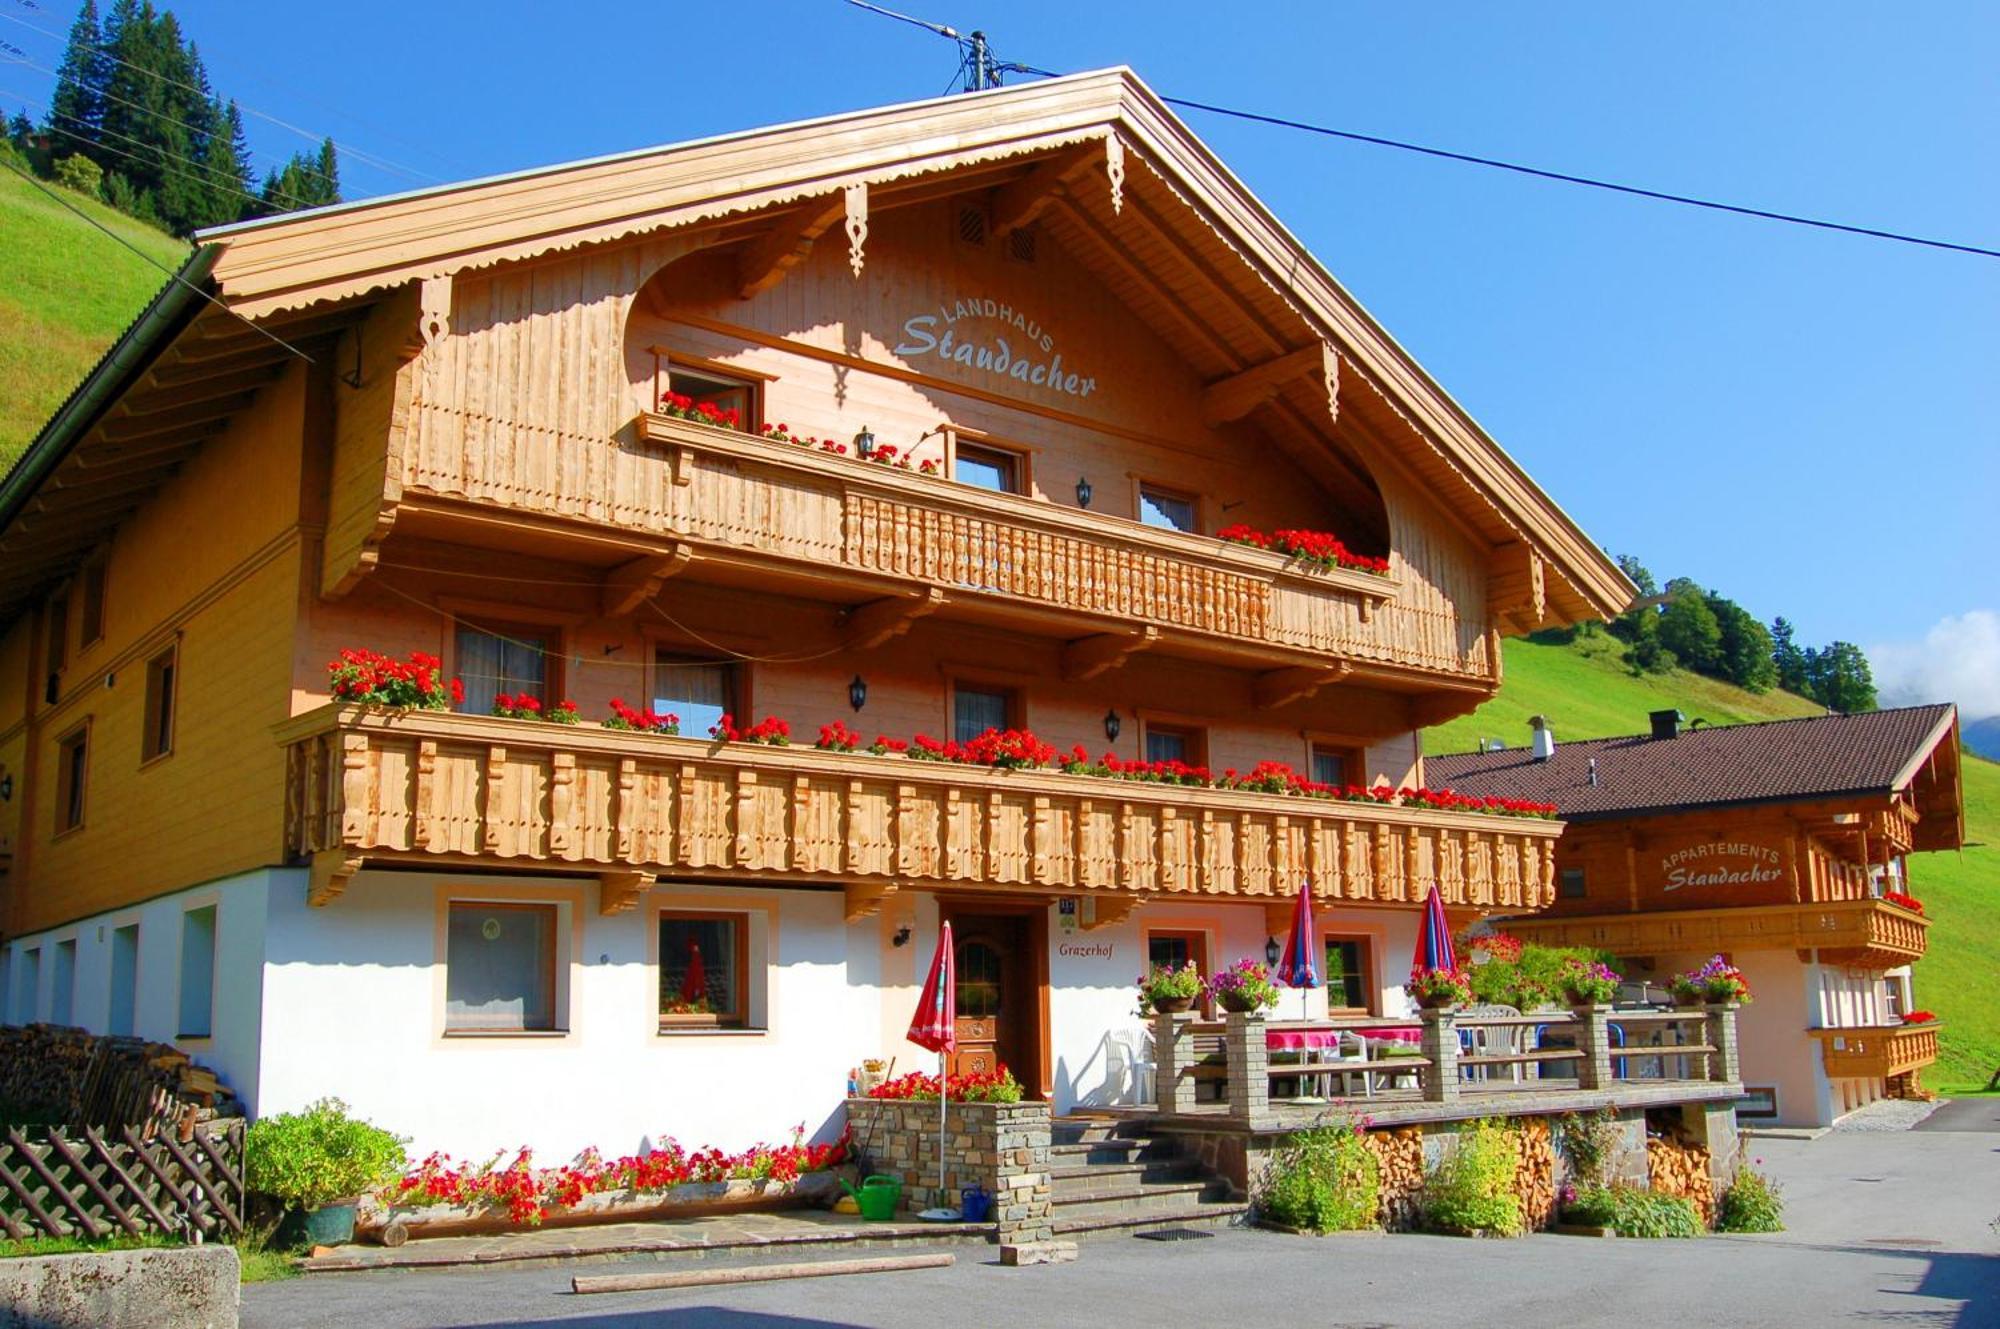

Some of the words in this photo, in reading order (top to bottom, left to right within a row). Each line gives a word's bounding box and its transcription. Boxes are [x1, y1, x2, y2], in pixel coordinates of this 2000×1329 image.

[941, 298, 1053, 352] LANDHAUS
[894, 315, 1096, 397] Staudacher
[1663, 842, 1780, 871] APPARTEMENTS
[1663, 863, 1782, 892] Staudacher
[1059, 943, 1113, 960] Grazerhof
